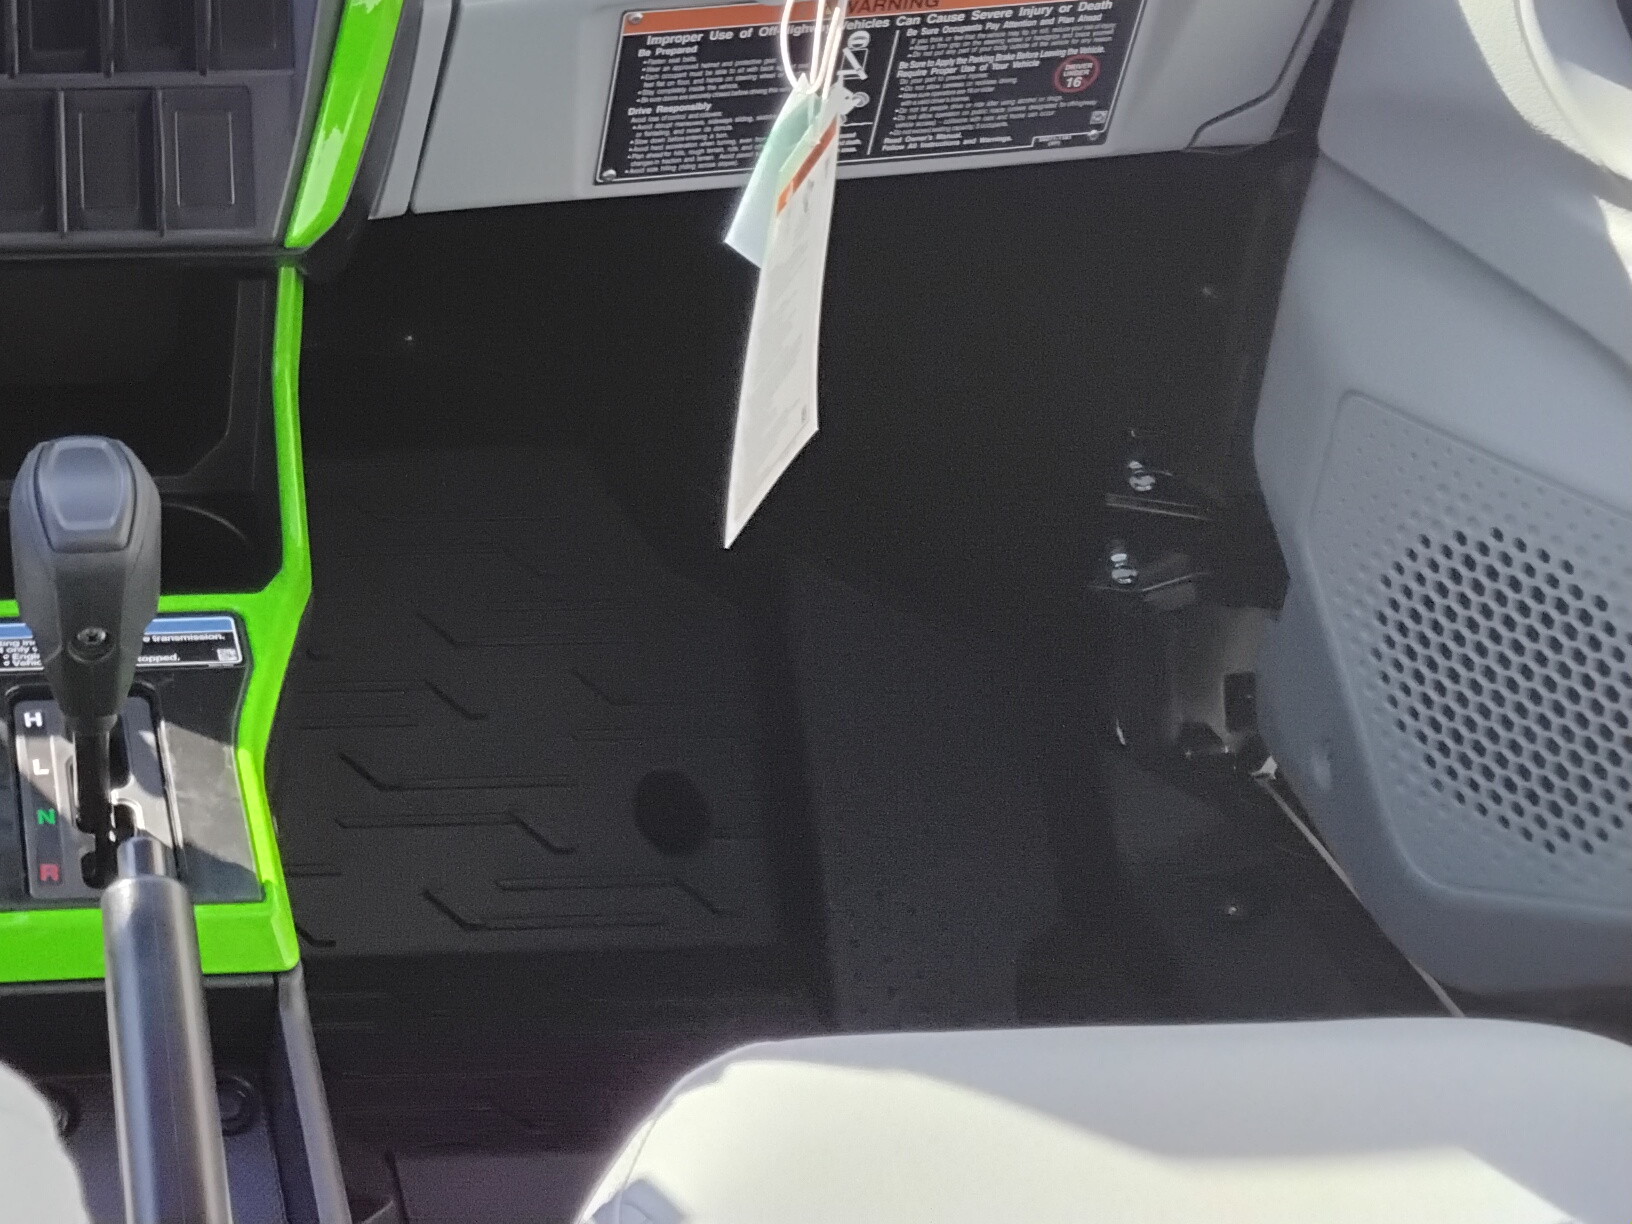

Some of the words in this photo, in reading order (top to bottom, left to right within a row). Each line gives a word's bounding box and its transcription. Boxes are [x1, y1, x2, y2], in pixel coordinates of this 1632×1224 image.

[646, 32, 703, 46] Improper
[709, 29, 733, 41] Use
[739, 27, 754, 38] of
[896, 16, 921, 26] Can
[926, 13, 966, 24] Cause
[971, 8, 1013, 20] Severe
[1018, 6, 1054, 18] Injury
[1058, 5, 1073, 13] or
[1077, 0, 1113, 11] Death
[637, 49, 651, 57] Be
[655, 45, 698, 57] Prepared
[1065, 62, 1093, 71] DRIVER
[1063, 69, 1090, 77] UNDER
[1066, 77, 1083, 88] 16
[627, 107, 652, 116] Drive
[656, 102, 712, 115] Responsibly
[152, 634, 225, 642] transmission.
[6, 646, 29, 654] only
[137, 652, 180, 663] topped.
[24, 711, 42, 727] H
[32, 759, 49, 775] L
[37, 808, 56, 824] N
[40, 863, 59, 881] R
